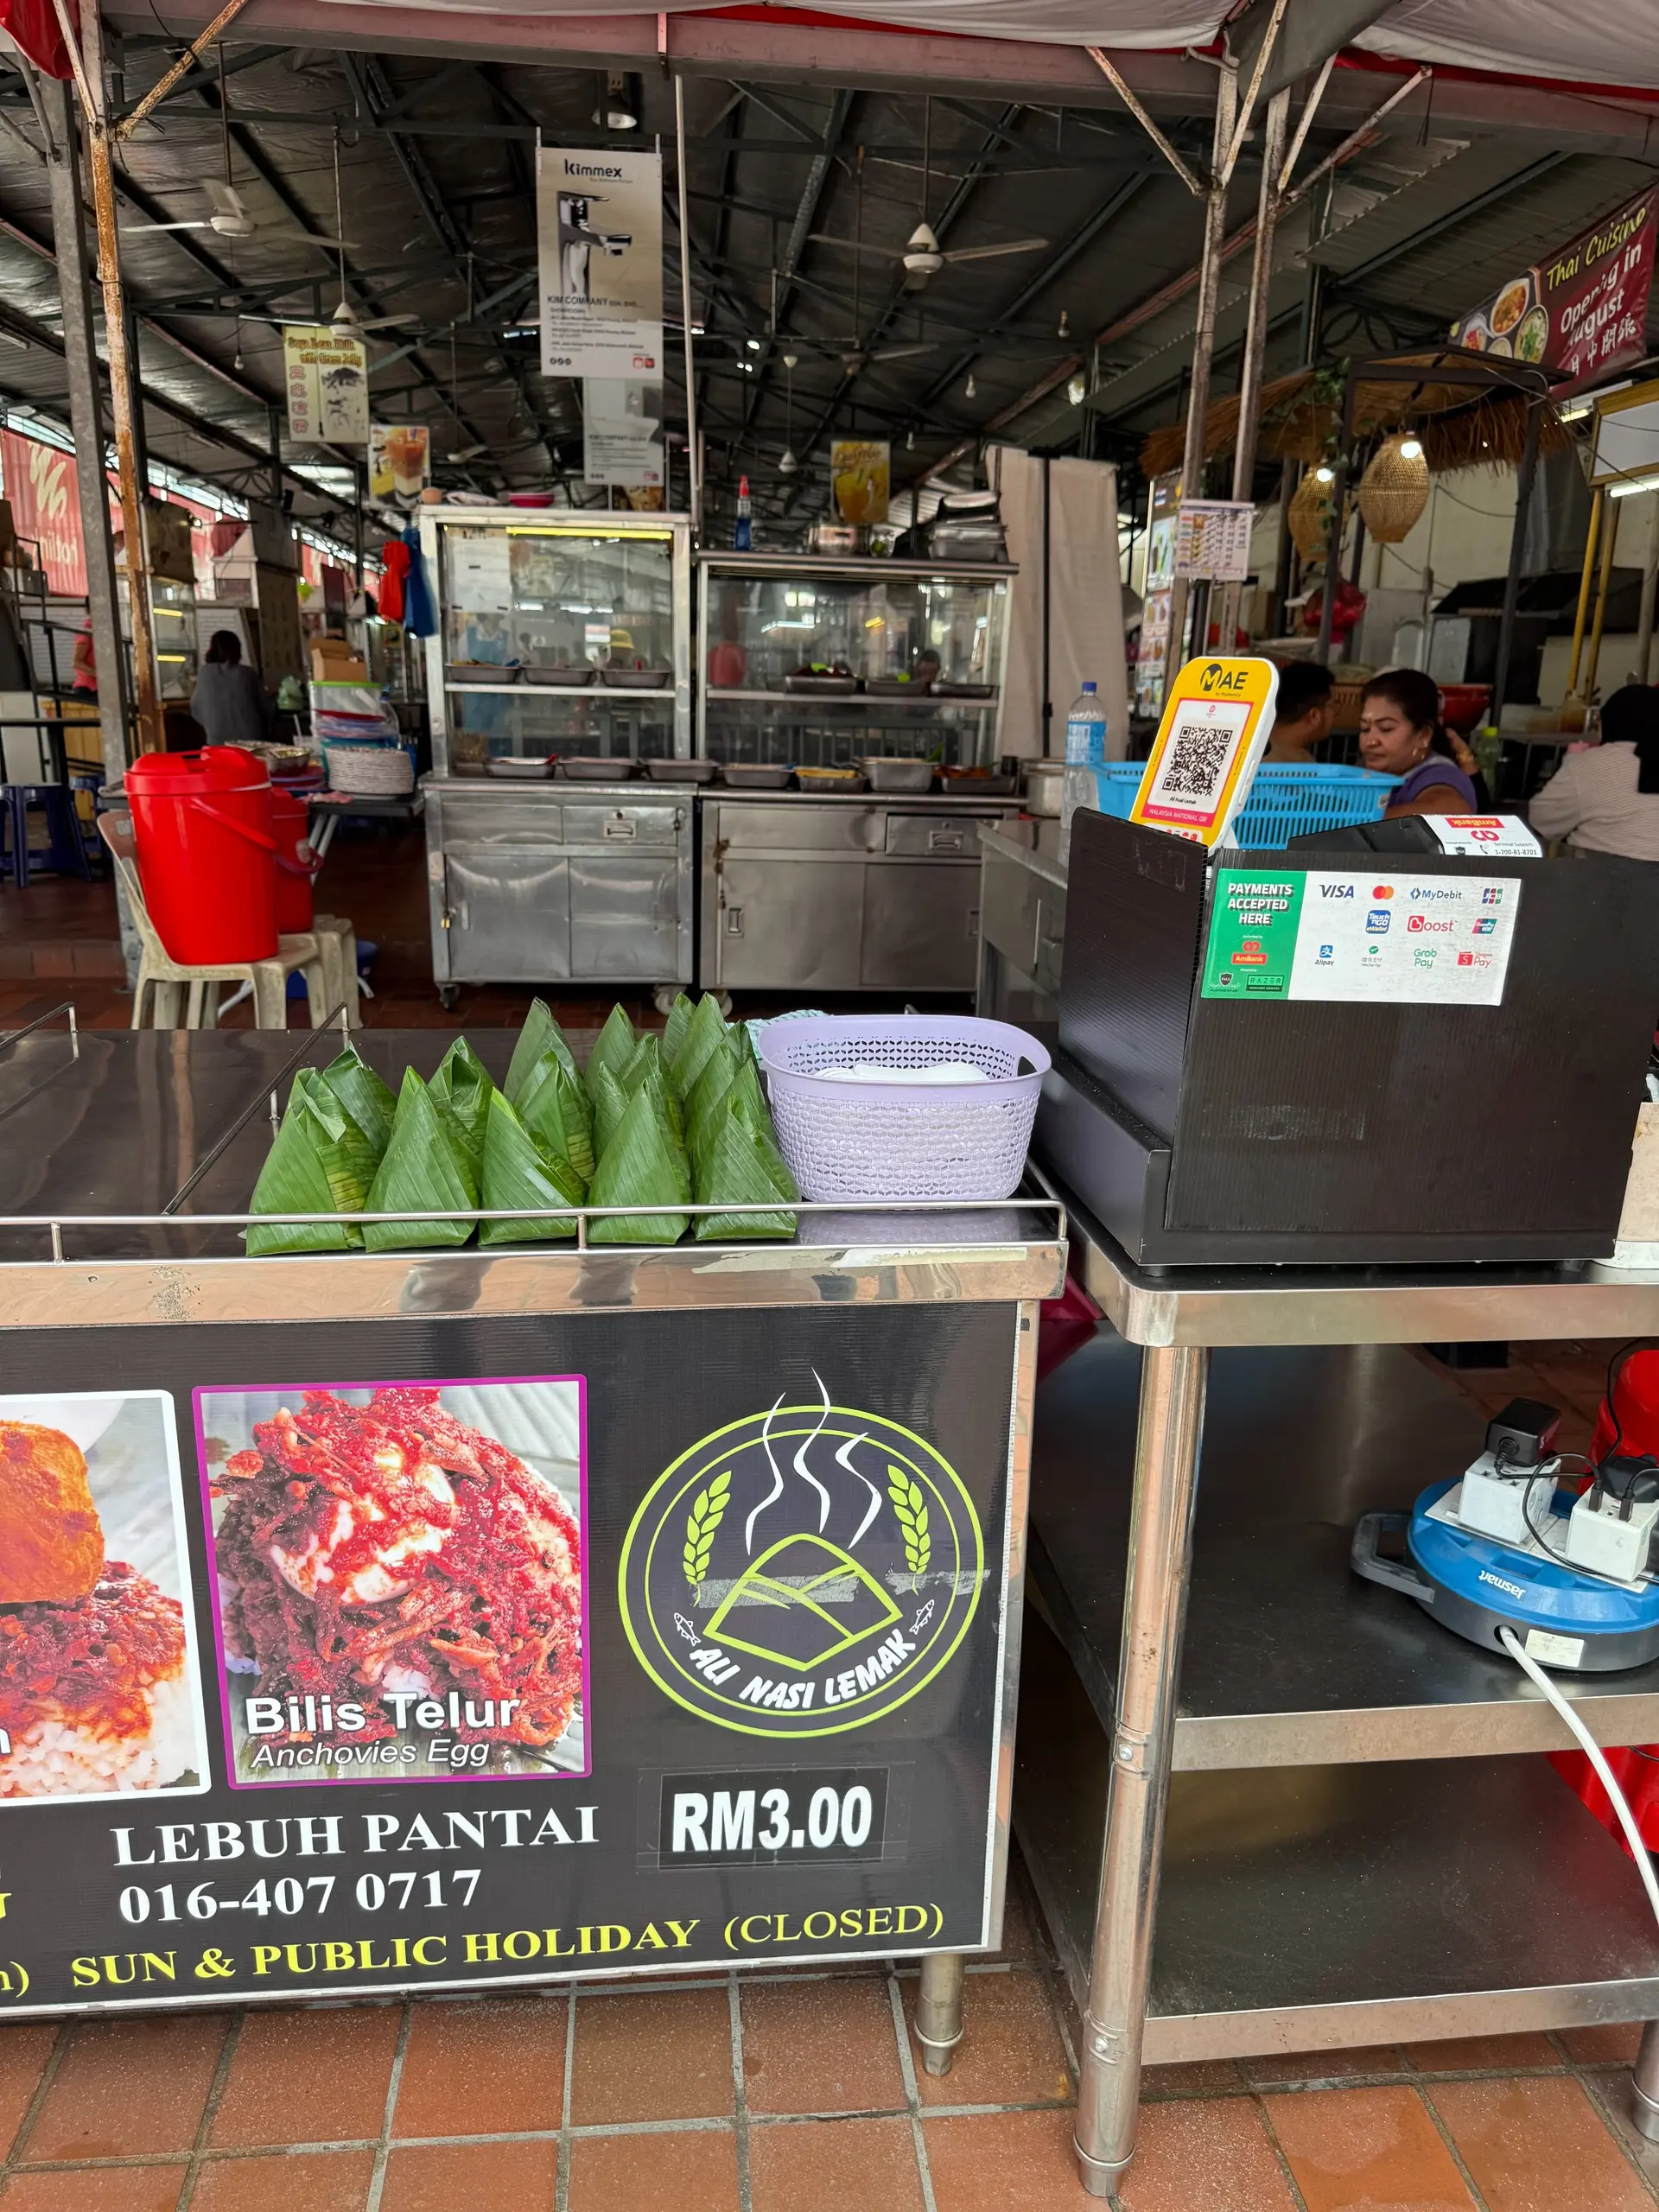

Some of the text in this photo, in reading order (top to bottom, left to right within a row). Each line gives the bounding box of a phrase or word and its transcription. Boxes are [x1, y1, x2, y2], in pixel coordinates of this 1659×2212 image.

[1546, 245, 1581, 292] Thai
[1624, 243, 1643, 272] in
[547, 296, 564, 304] KIM
[1200, 664, 1249, 691] MAE
[1148, 808, 1173, 817] MALAYSIA
[1173, 811, 1198, 822] NATIONAL
[1228, 883, 1294, 896] PAYMENTS
[1319, 884, 1354, 899] VISA
[1421, 889, 1462, 900] MyDebit
[1227, 898, 1288, 911] ACCEPTED
[1238, 912, 1272, 925] HERE
[1414, 948, 1437, 957] Grab
[1414, 957, 1433, 969] Pay
[1473, 956, 1491, 969] Pay
[1478, 1569, 1526, 1599] Jasmart
[689, 1628, 916, 1709] ALI NASI LEMAK
[245, 1691, 521, 1735] Bilis Telur
[251, 1738, 490, 1769] Anchovies Egg
[671, 1784, 874, 1853] RM3.00
[110, 1806, 601, 1866] LEBUH PANTAI
[119, 1868, 482, 1924] 016-407 0717
[71, 1948, 176, 1986] SUN
[194, 1948, 236, 1980] &
[252, 1935, 448, 1977] PUBLIC
[464, 1918, 701, 1964] HOLIDAY
[723, 1903, 944, 1952] (CLOSED)
